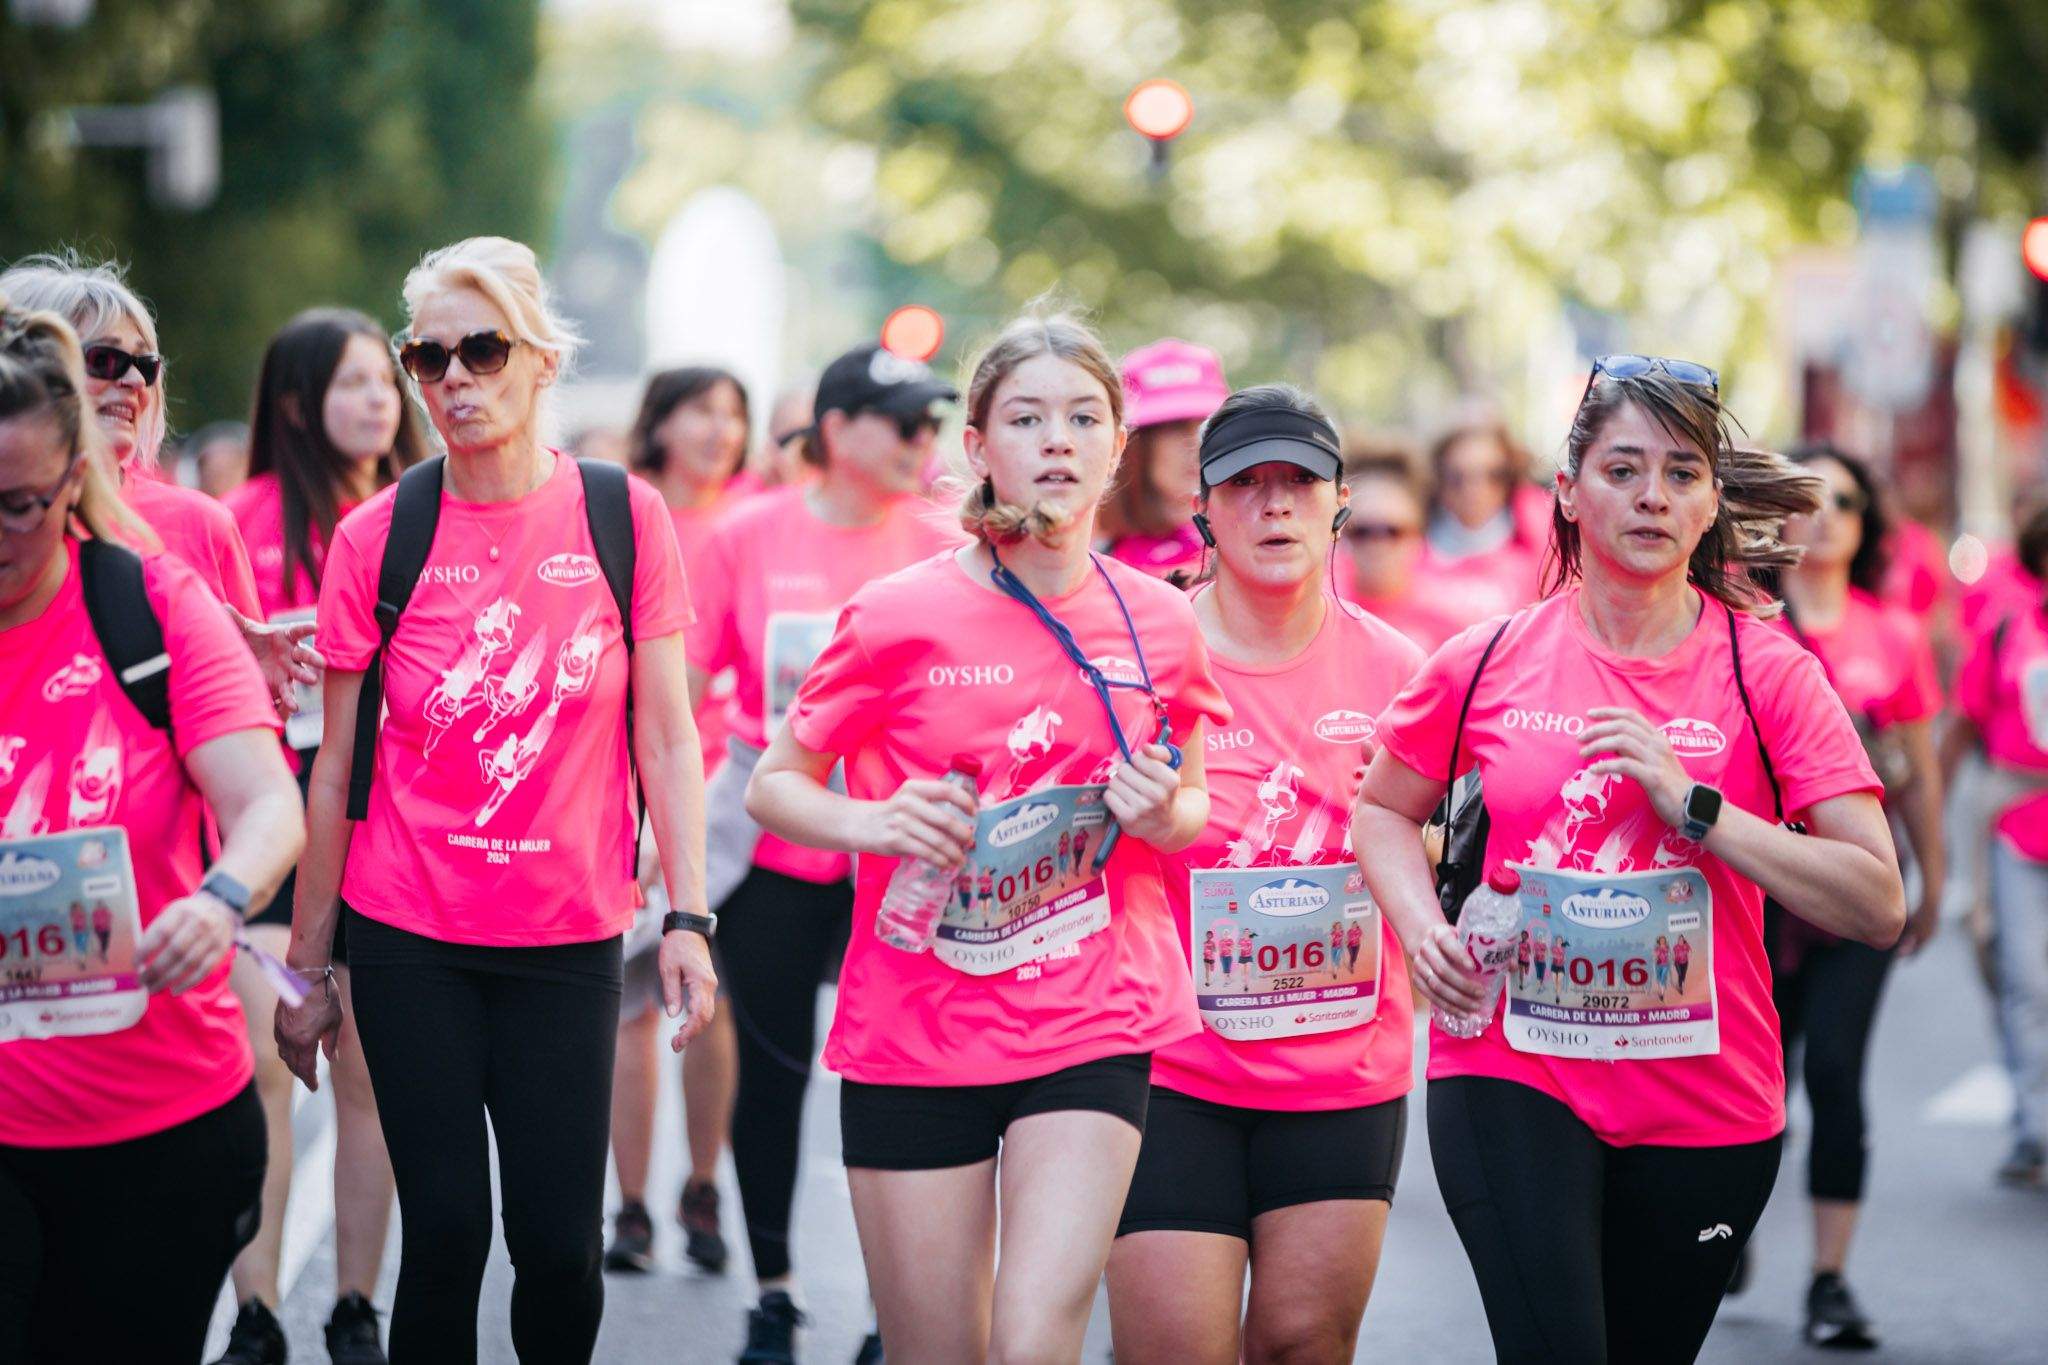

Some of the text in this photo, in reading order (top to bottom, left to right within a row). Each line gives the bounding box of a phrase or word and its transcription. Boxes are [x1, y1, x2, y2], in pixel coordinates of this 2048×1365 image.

[929, 664, 1014, 686] OYSHO
[1321, 723, 1372, 736] ASTURIANA
[1503, 708, 1584, 736] OYSHO
[1206, 729, 1254, 751] SHO
[994, 811, 1056, 842] ASTURIANA
[448, 833, 551, 852] CARRERA DE LA MUJER
[487, 851, 510, 864] 2024
[998, 856, 1054, 903] 016
[1008, 895, 1041, 918] 10750
[1254, 894, 1325, 909] ASTURIANA
[1566, 901, 1645, 919] ASTURIANA
[955, 889, 1087, 943] CARRERA DE LA MUJER MADRID
[954, 945, 1015, 964] OYSHO
[1257, 941, 1325, 972] 016
[1016, 966, 1042, 982] 2024
[1569, 957, 1648, 987] 016
[1273, 976, 1304, 991] 2522
[1216, 986, 1358, 1007] CARRERA DE LA MUJER MADRID
[1583, 996, 1629, 1010] 29072
[1215, 1015, 1274, 1030] OYSHO
[1308, 1008, 1359, 1023] Santander
[1530, 1005, 1690, 1024] CARRERA DE LA MUJER MADRID
[1527, 1026, 1588, 1046] OYSHO
[1632, 1034, 1694, 1047] Santander
